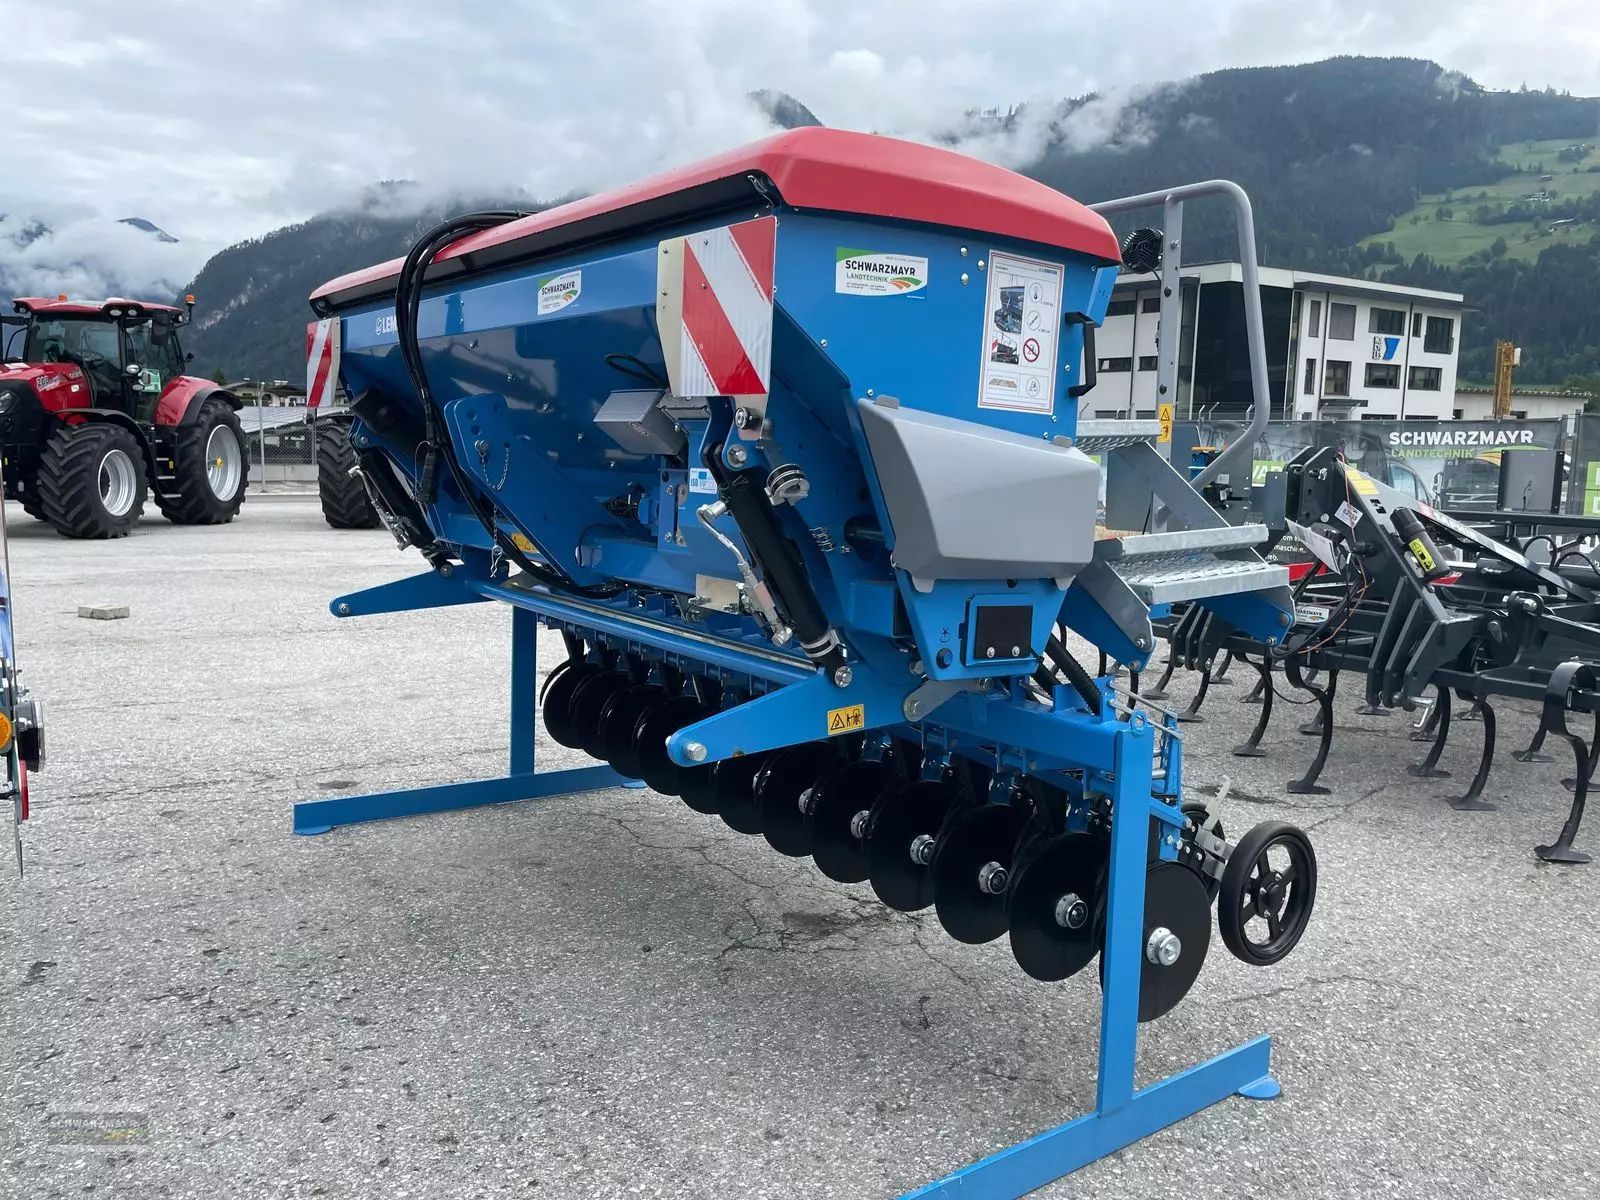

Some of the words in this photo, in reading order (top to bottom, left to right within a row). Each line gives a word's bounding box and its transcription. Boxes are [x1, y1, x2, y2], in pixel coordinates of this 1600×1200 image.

[845, 260, 916, 276] SCHWARZMAYR
[846, 272, 888, 282] LANDTECHNIK
[541, 281, 575, 295] SCHWARZMAYR
[1389, 430, 1534, 446] SCHWARZMAYR
[1391, 448, 1474, 459] LANDTECHNIK
